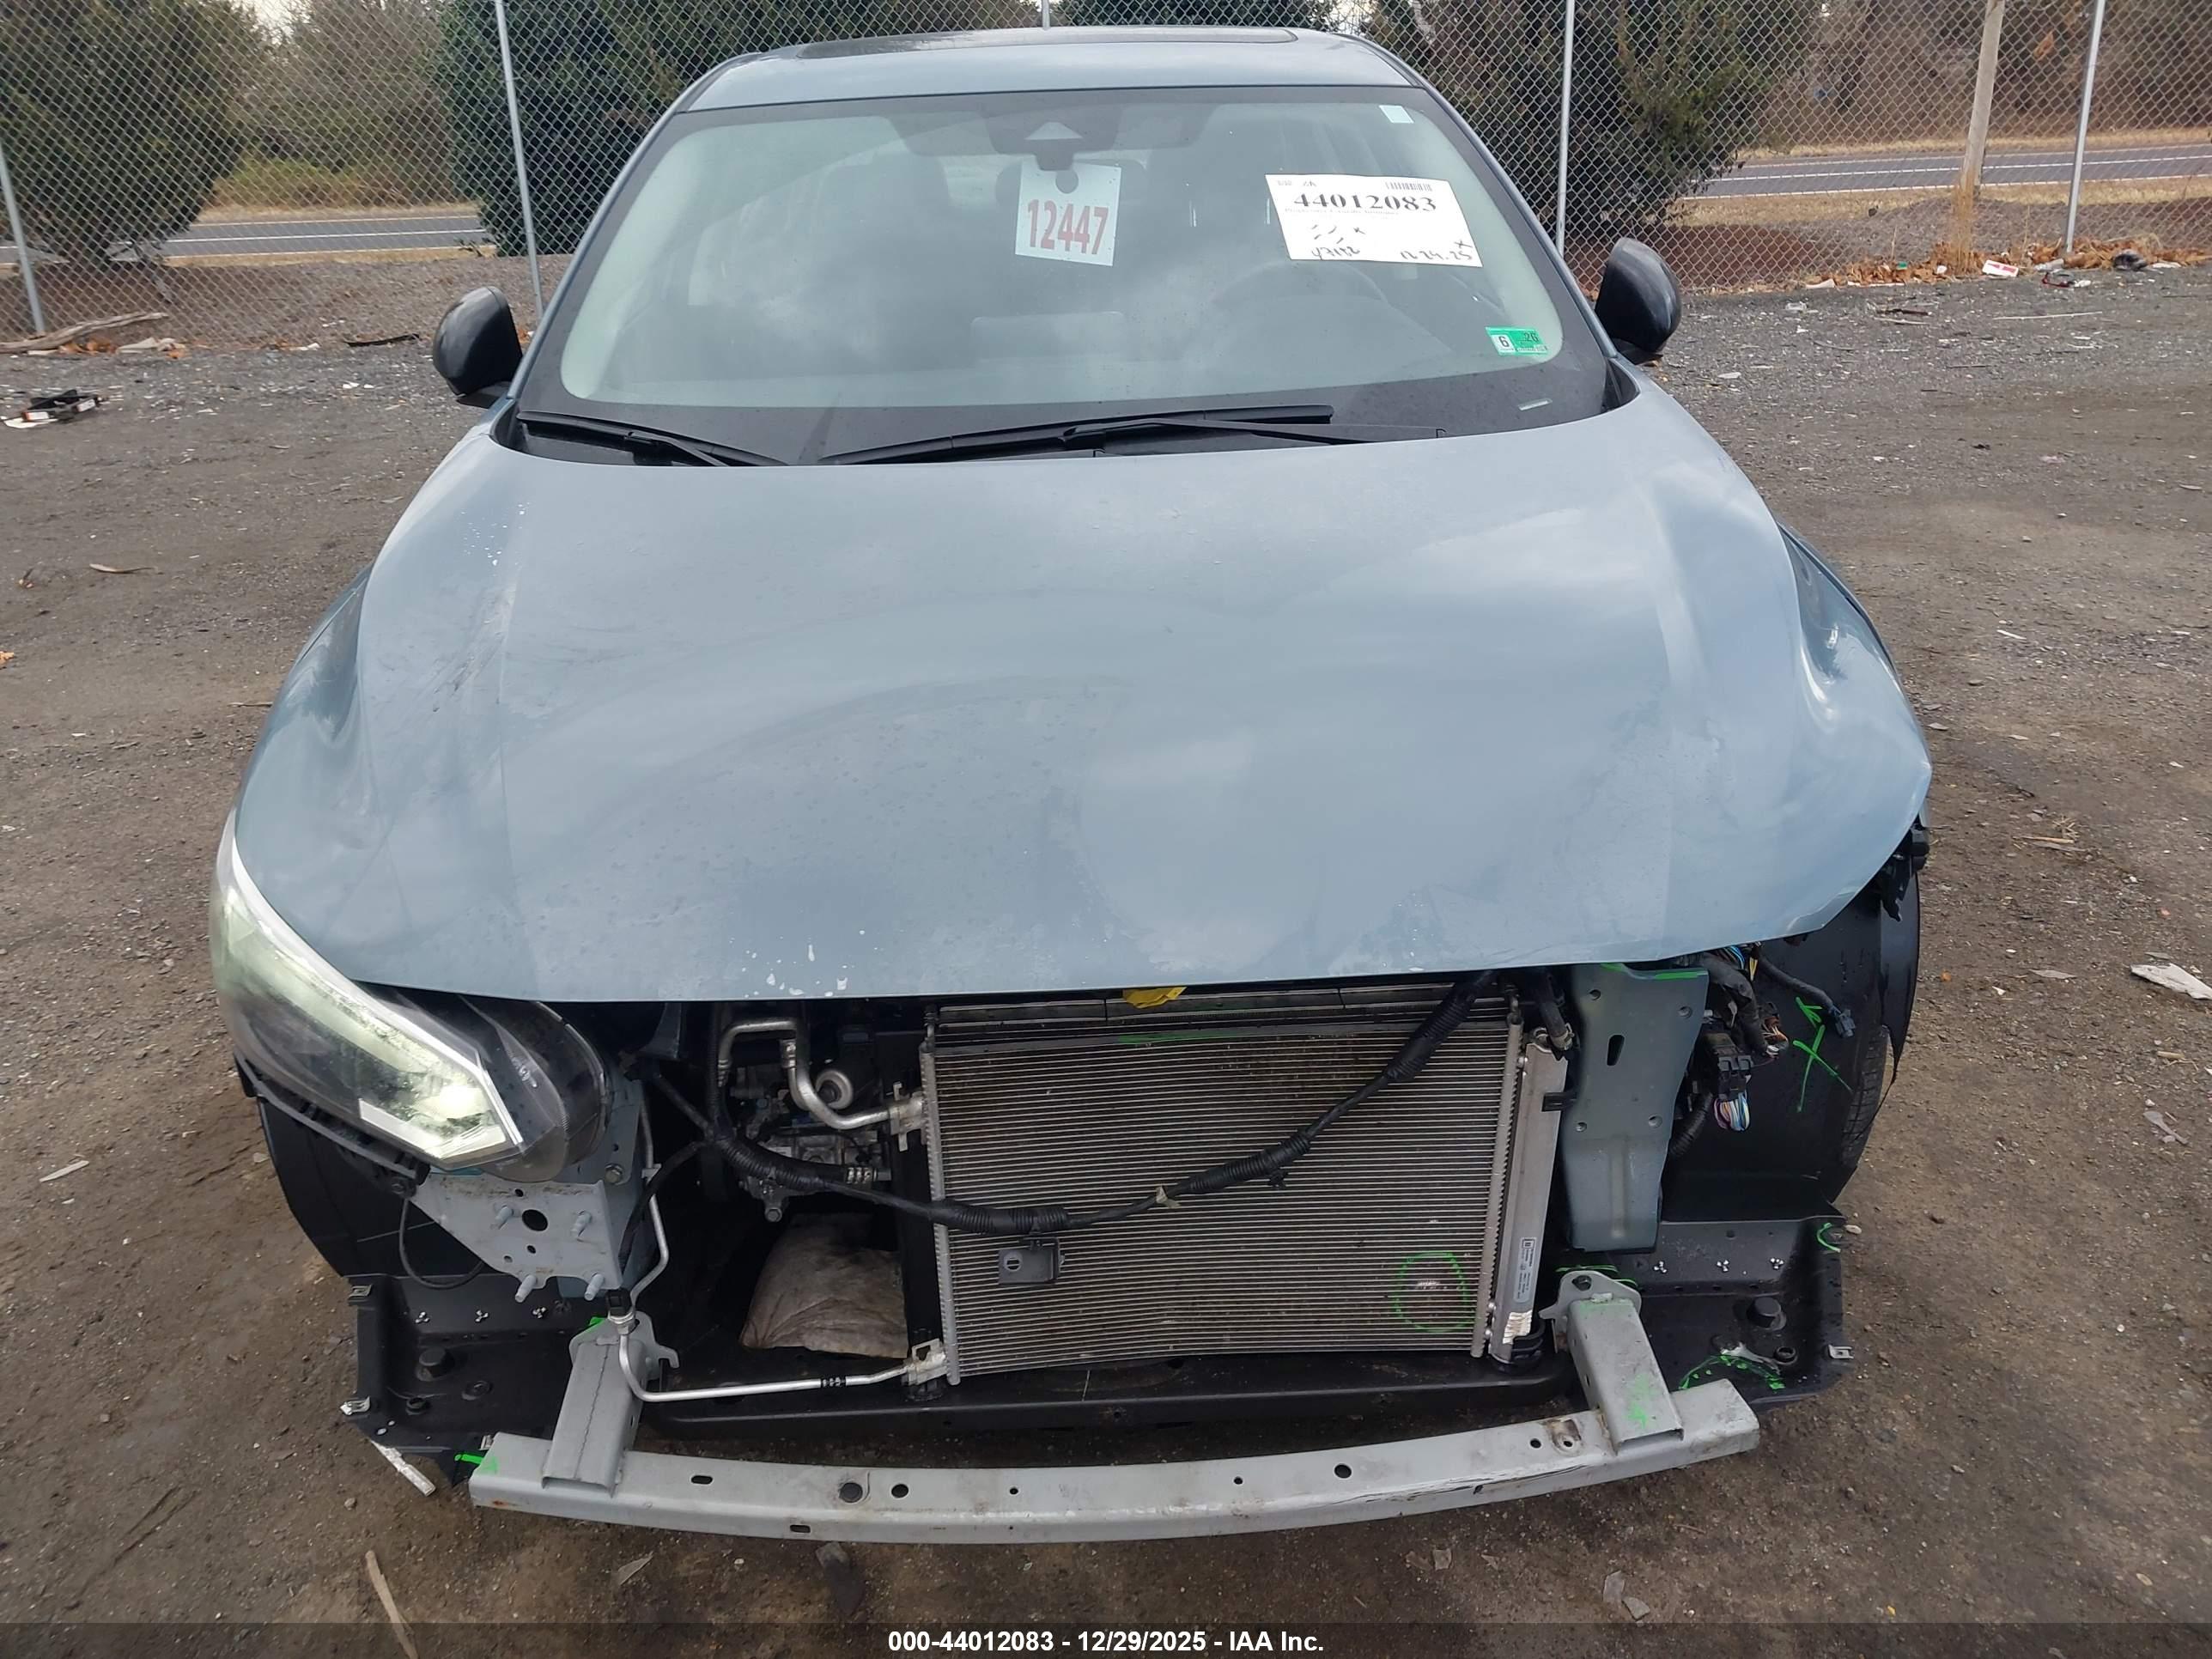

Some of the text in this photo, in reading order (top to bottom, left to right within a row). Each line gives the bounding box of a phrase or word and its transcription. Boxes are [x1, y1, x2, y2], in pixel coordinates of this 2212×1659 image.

[1294, 193, 1437, 211] 44012083
[1028, 199, 1109, 255] 12447
[1498, 336, 1510, 348] 6
